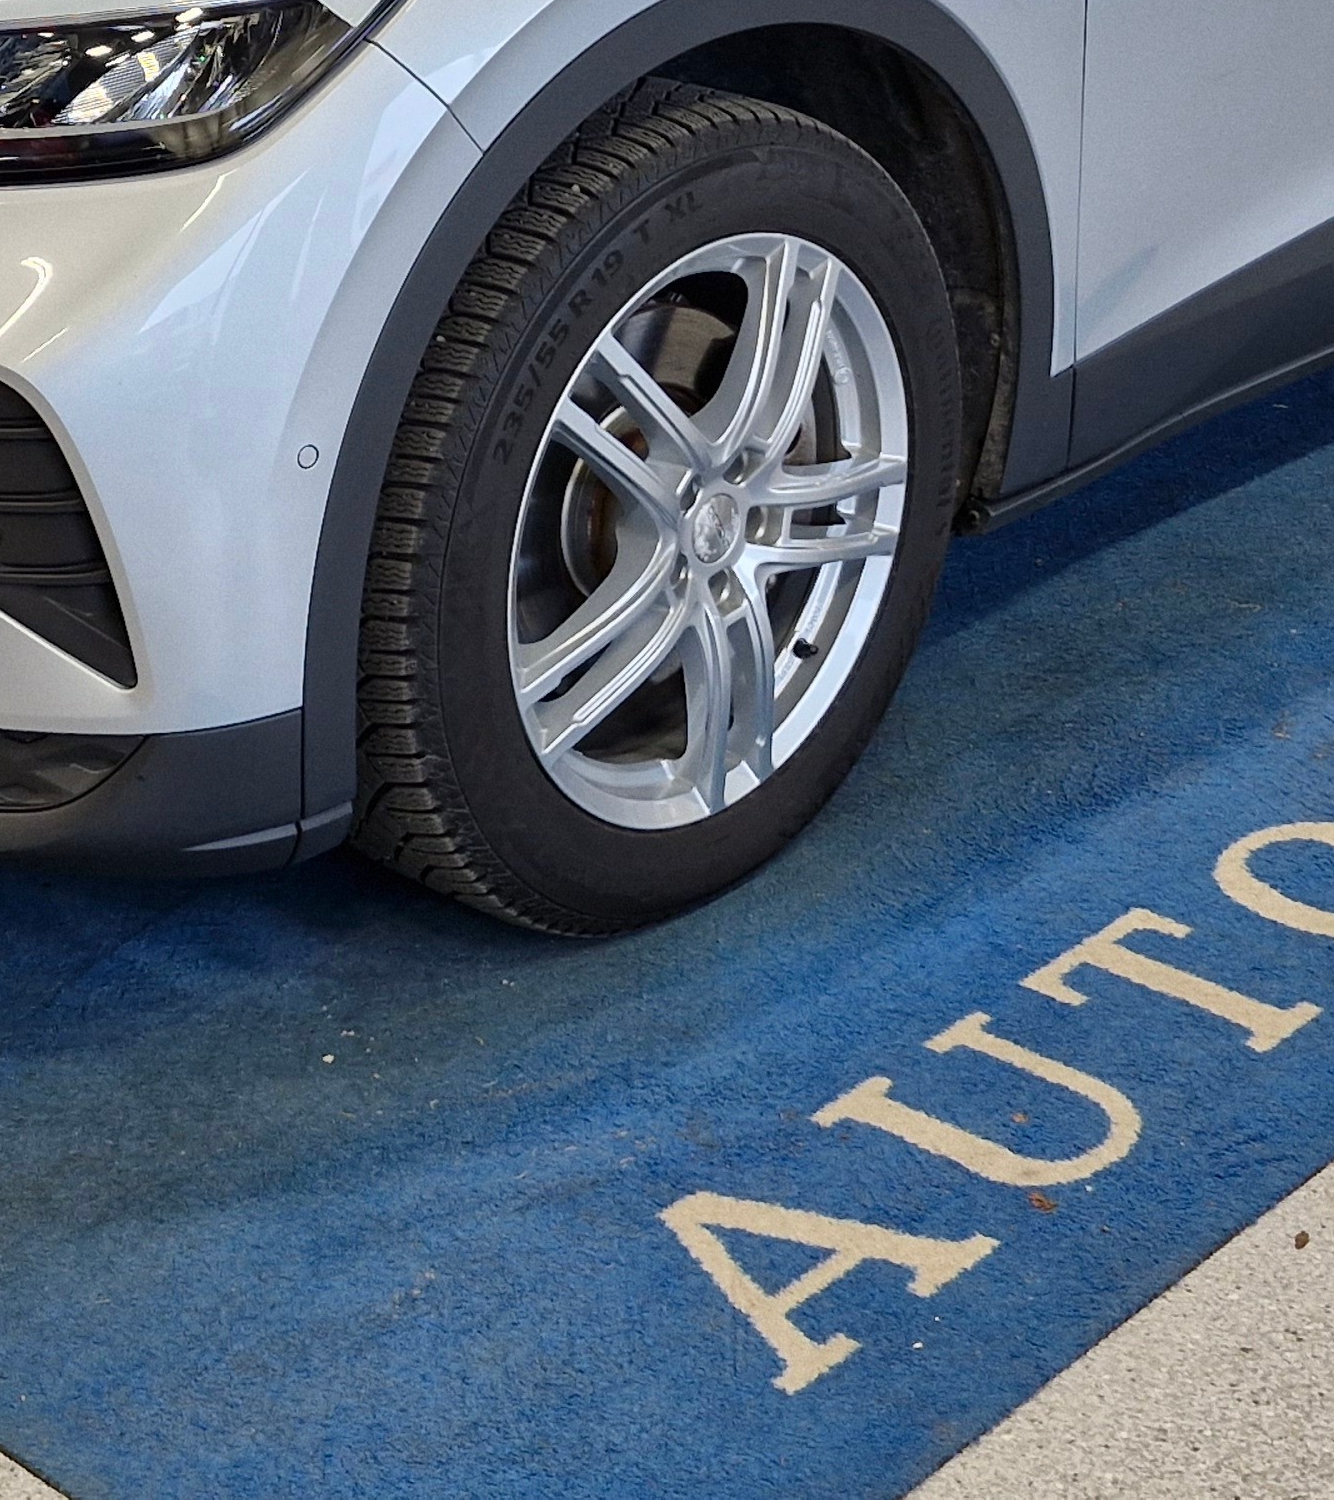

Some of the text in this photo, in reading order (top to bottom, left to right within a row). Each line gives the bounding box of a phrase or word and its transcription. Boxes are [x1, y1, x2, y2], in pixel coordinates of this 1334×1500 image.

[493, 317, 570, 465] 235/55
[591, 251, 624, 287] 19
[664, 190, 704, 221] XL
